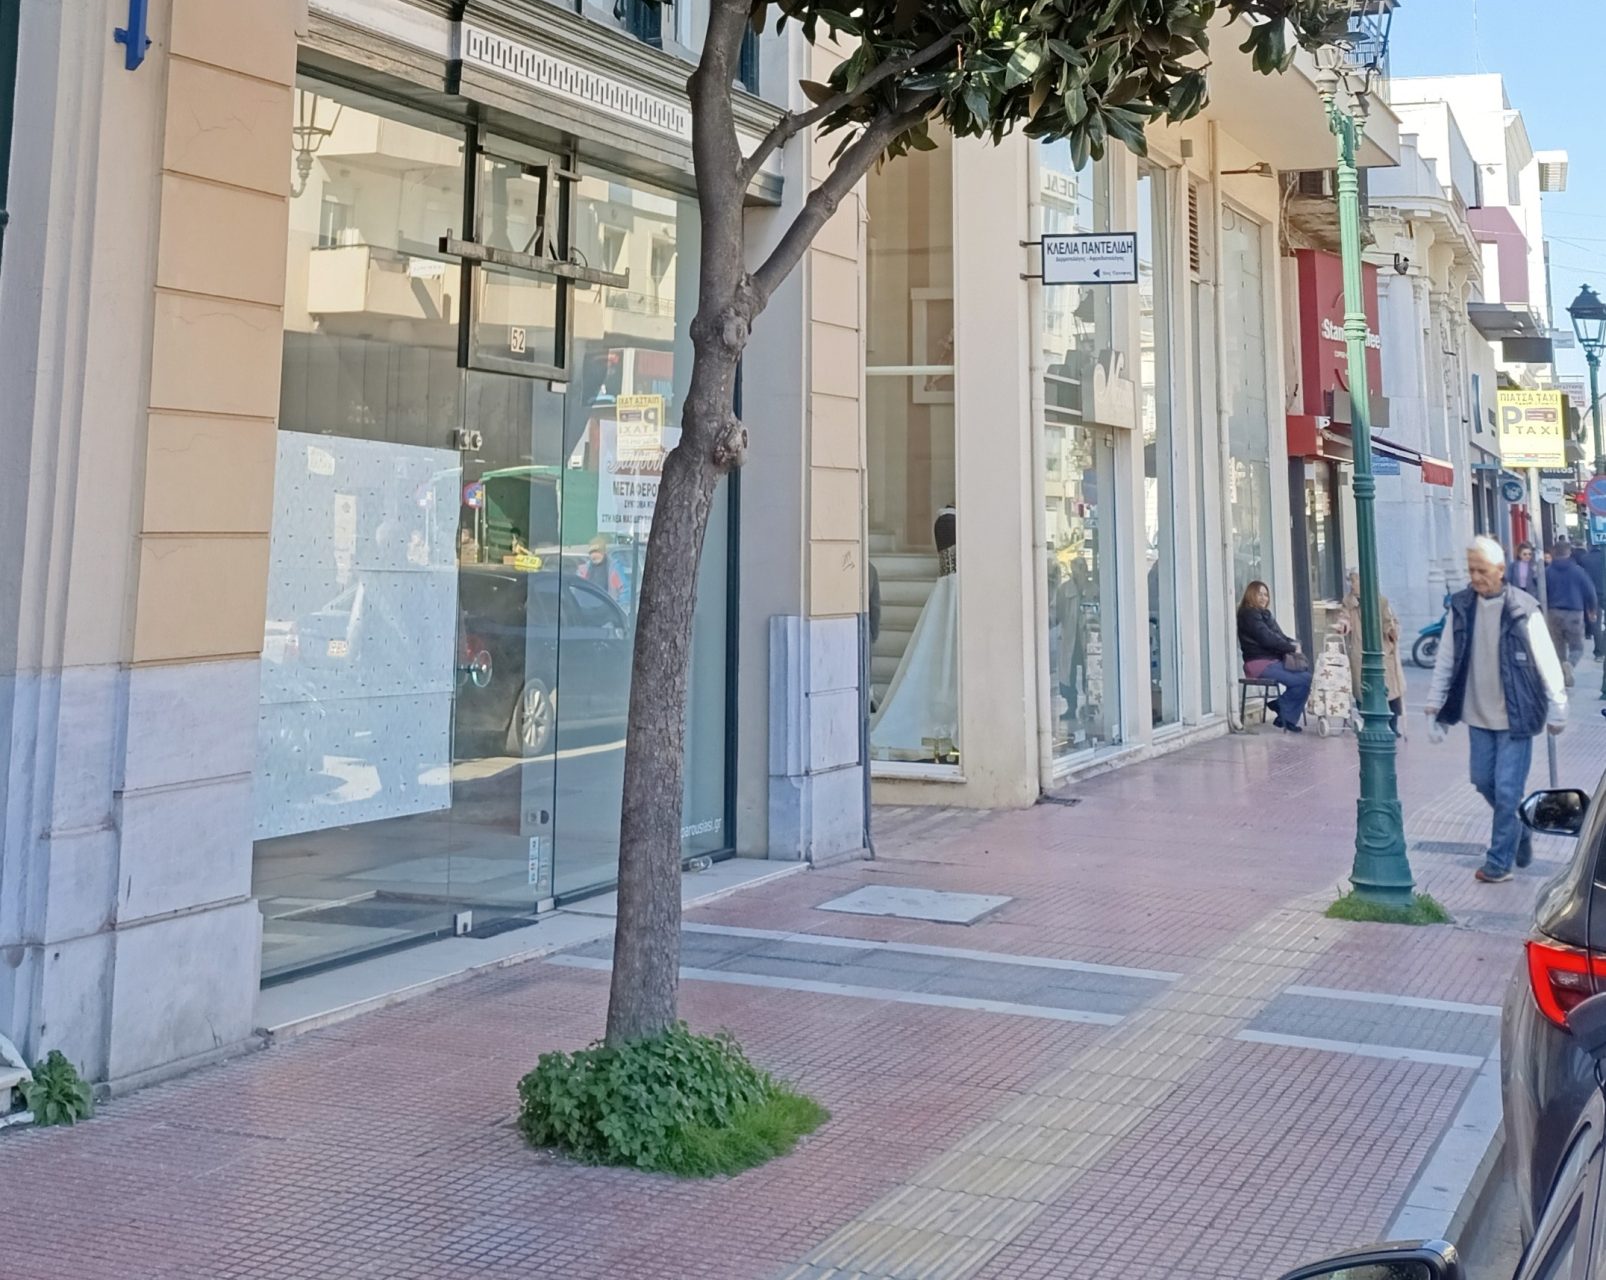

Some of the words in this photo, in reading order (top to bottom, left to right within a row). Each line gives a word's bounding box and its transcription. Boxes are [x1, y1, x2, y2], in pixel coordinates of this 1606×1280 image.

[1046, 241, 1079, 255] ΚΛΕΛΙΑ
[1081, 240, 1133, 254] ΠΑΝΤΕΛΙΔΗ
[512, 329, 525, 351] 52
[1500, 393, 1534, 402] ΠΙΑΤΣΑ
[1502, 405, 1522, 435] P
[1515, 426, 1559, 435] TAXI
[612, 481, 659, 497] ΜΕΤΑΦΕΡΟ
